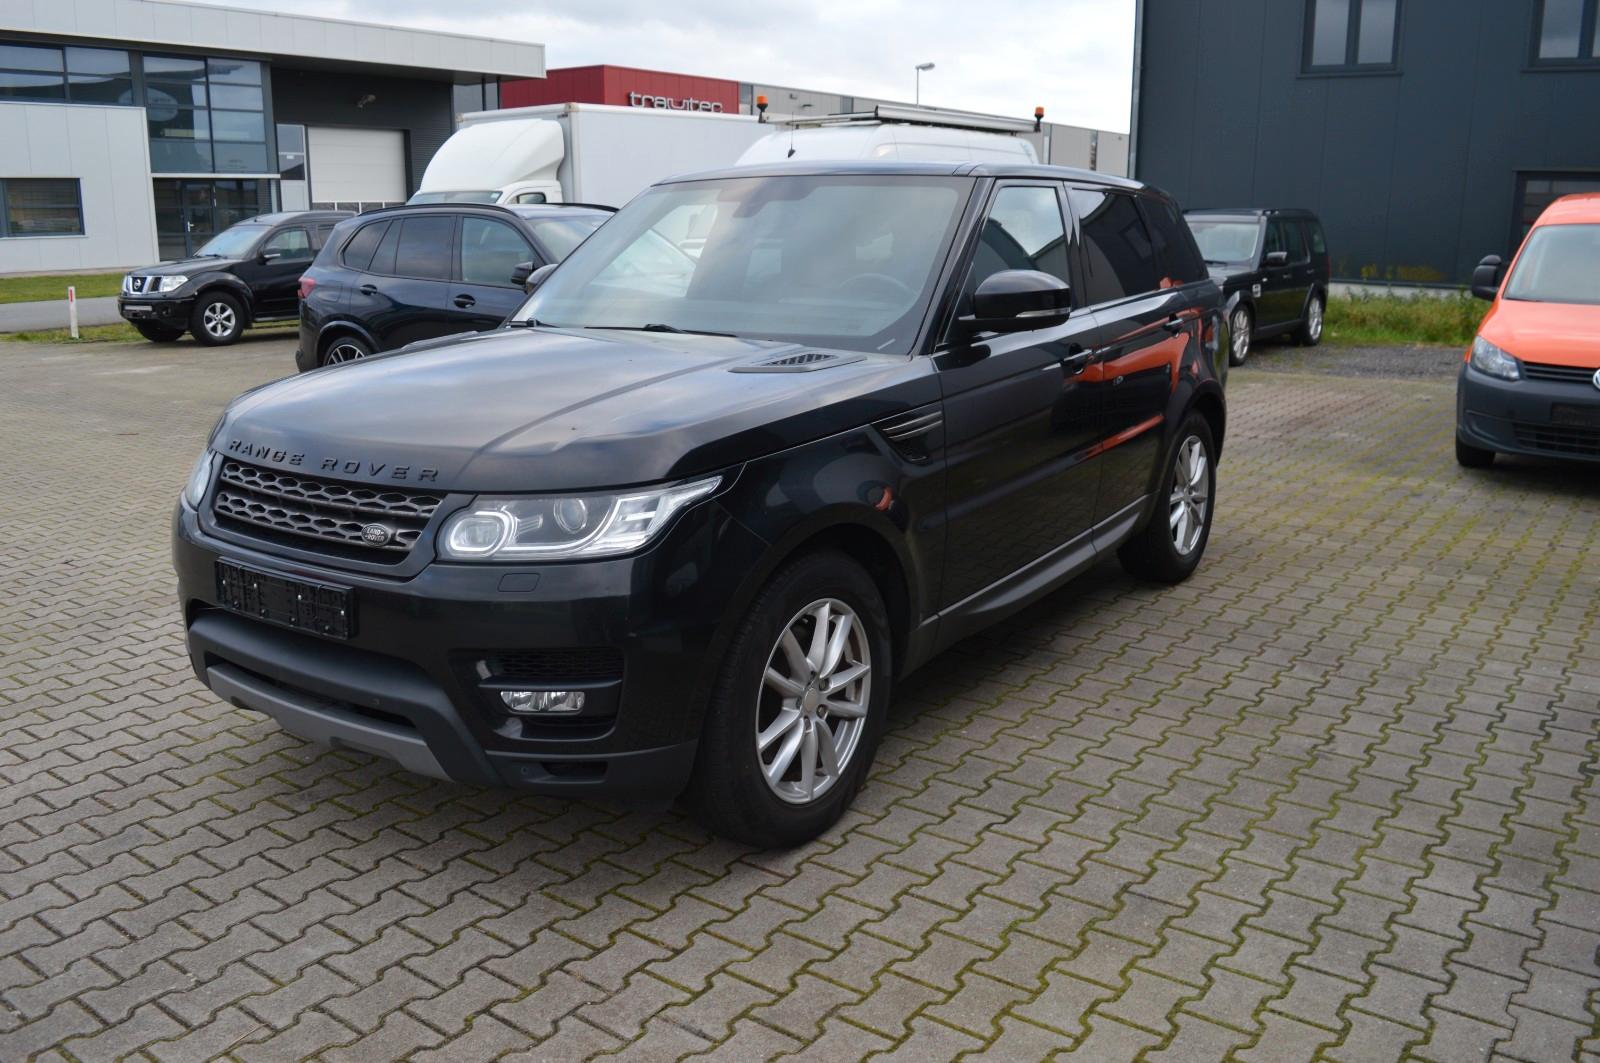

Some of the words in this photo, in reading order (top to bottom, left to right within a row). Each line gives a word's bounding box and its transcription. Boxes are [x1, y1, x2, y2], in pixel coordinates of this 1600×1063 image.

[228, 439, 305, 466] RANGE
[320, 457, 439, 482] ROVER
[366, 527, 381, 536] LAND
